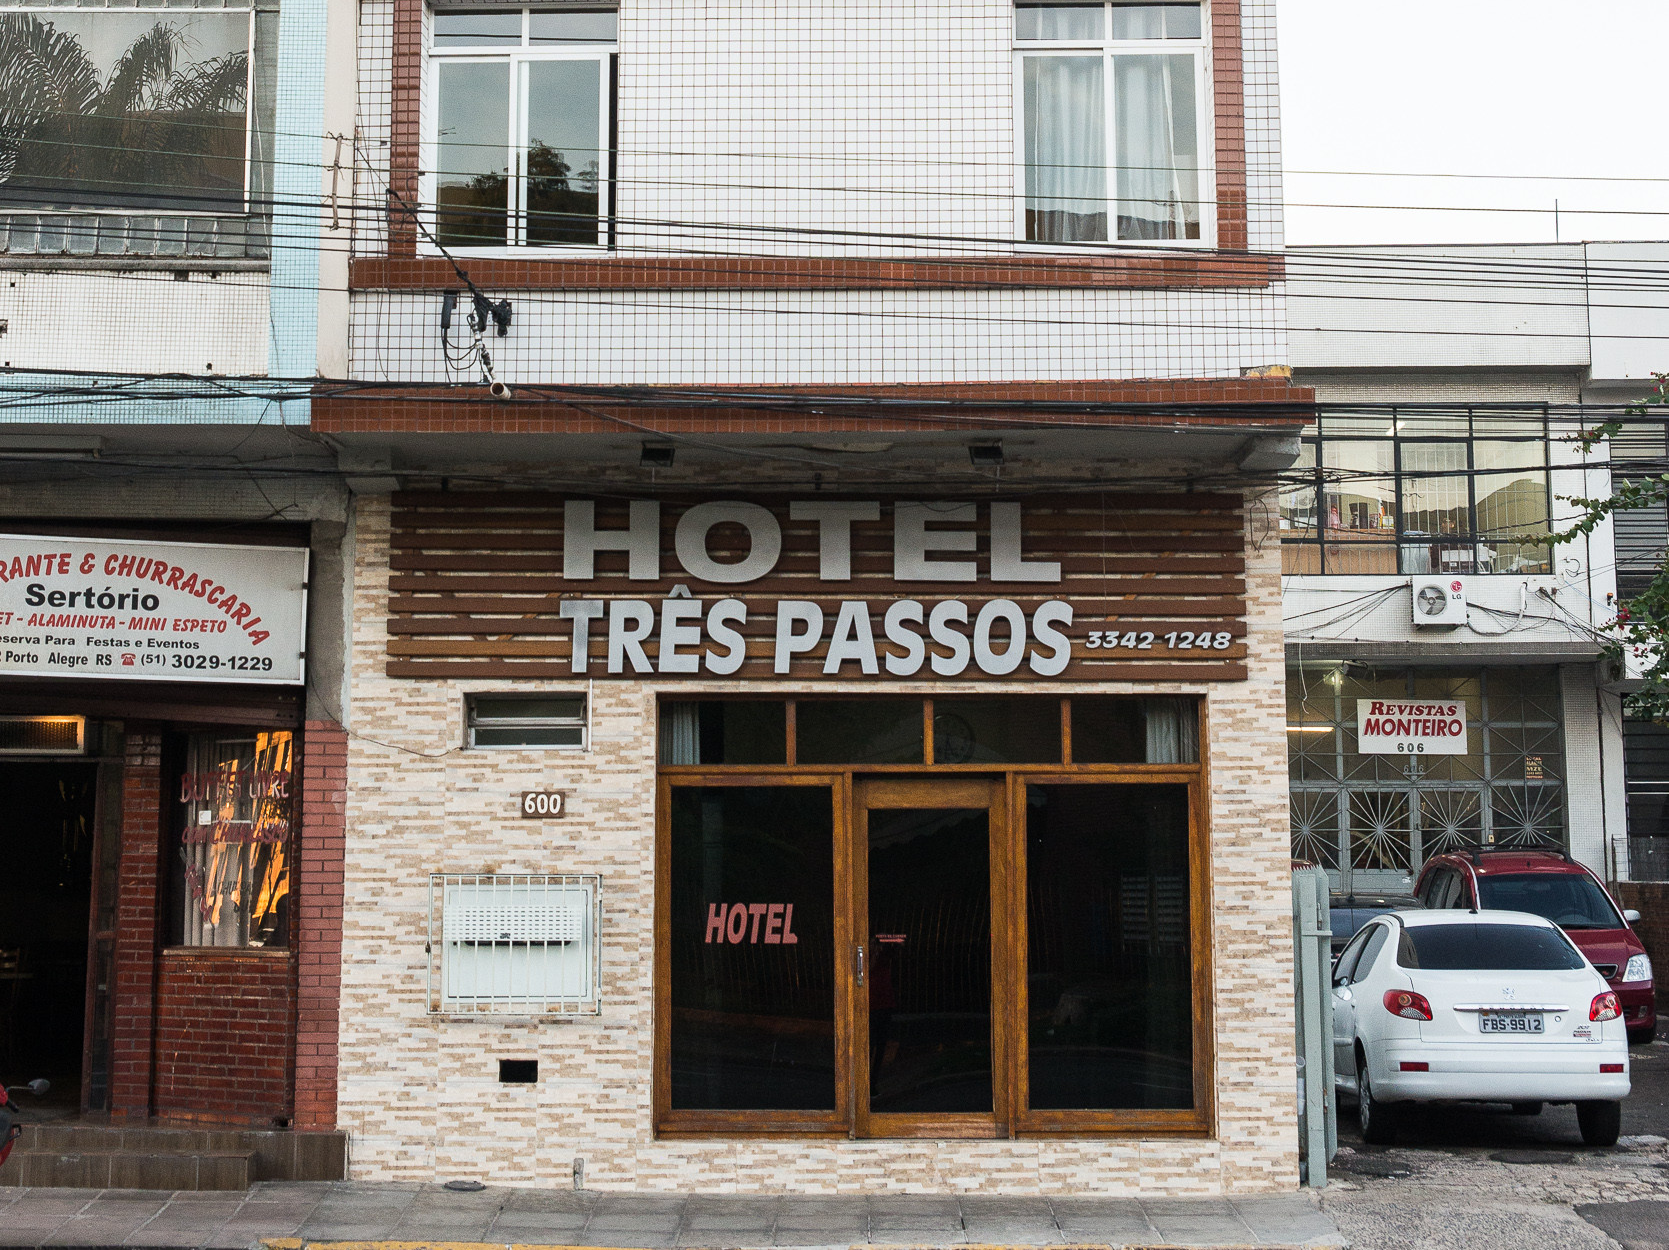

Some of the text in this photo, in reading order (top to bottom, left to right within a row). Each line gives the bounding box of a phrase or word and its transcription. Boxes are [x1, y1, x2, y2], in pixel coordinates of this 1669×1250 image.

[562, 500, 1063, 584] HOTEL
[25, 583, 160, 612] Sertório
[79, 553, 95, 575] &
[104, 553, 270, 646] CHURRASCARIA
[27, 613, 116, 629] ALAMINUTA
[128, 617, 167, 631] MINI
[172, 618, 227, 633] ESPETO
[559, 582, 1233, 677] TRÊS PASSOS 3342 1248
[45, 635, 75, 646] Para
[86, 636, 131, 648] Festas
[135, 639, 143, 648] e
[147, 638, 200, 649] Eventos
[5, 650, 39, 663] Porto
[48, 652, 88, 667] Alegre
[96, 654, 112, 666] RS
[140, 654, 166, 667] (51)
[171, 654, 273, 671] 3029-1229
[1363, 718, 1463, 736] MONTEIRO
[1397, 743, 1424, 753] 606
[524, 792, 561, 815] 600
[705, 902, 798, 945] HOTEL
